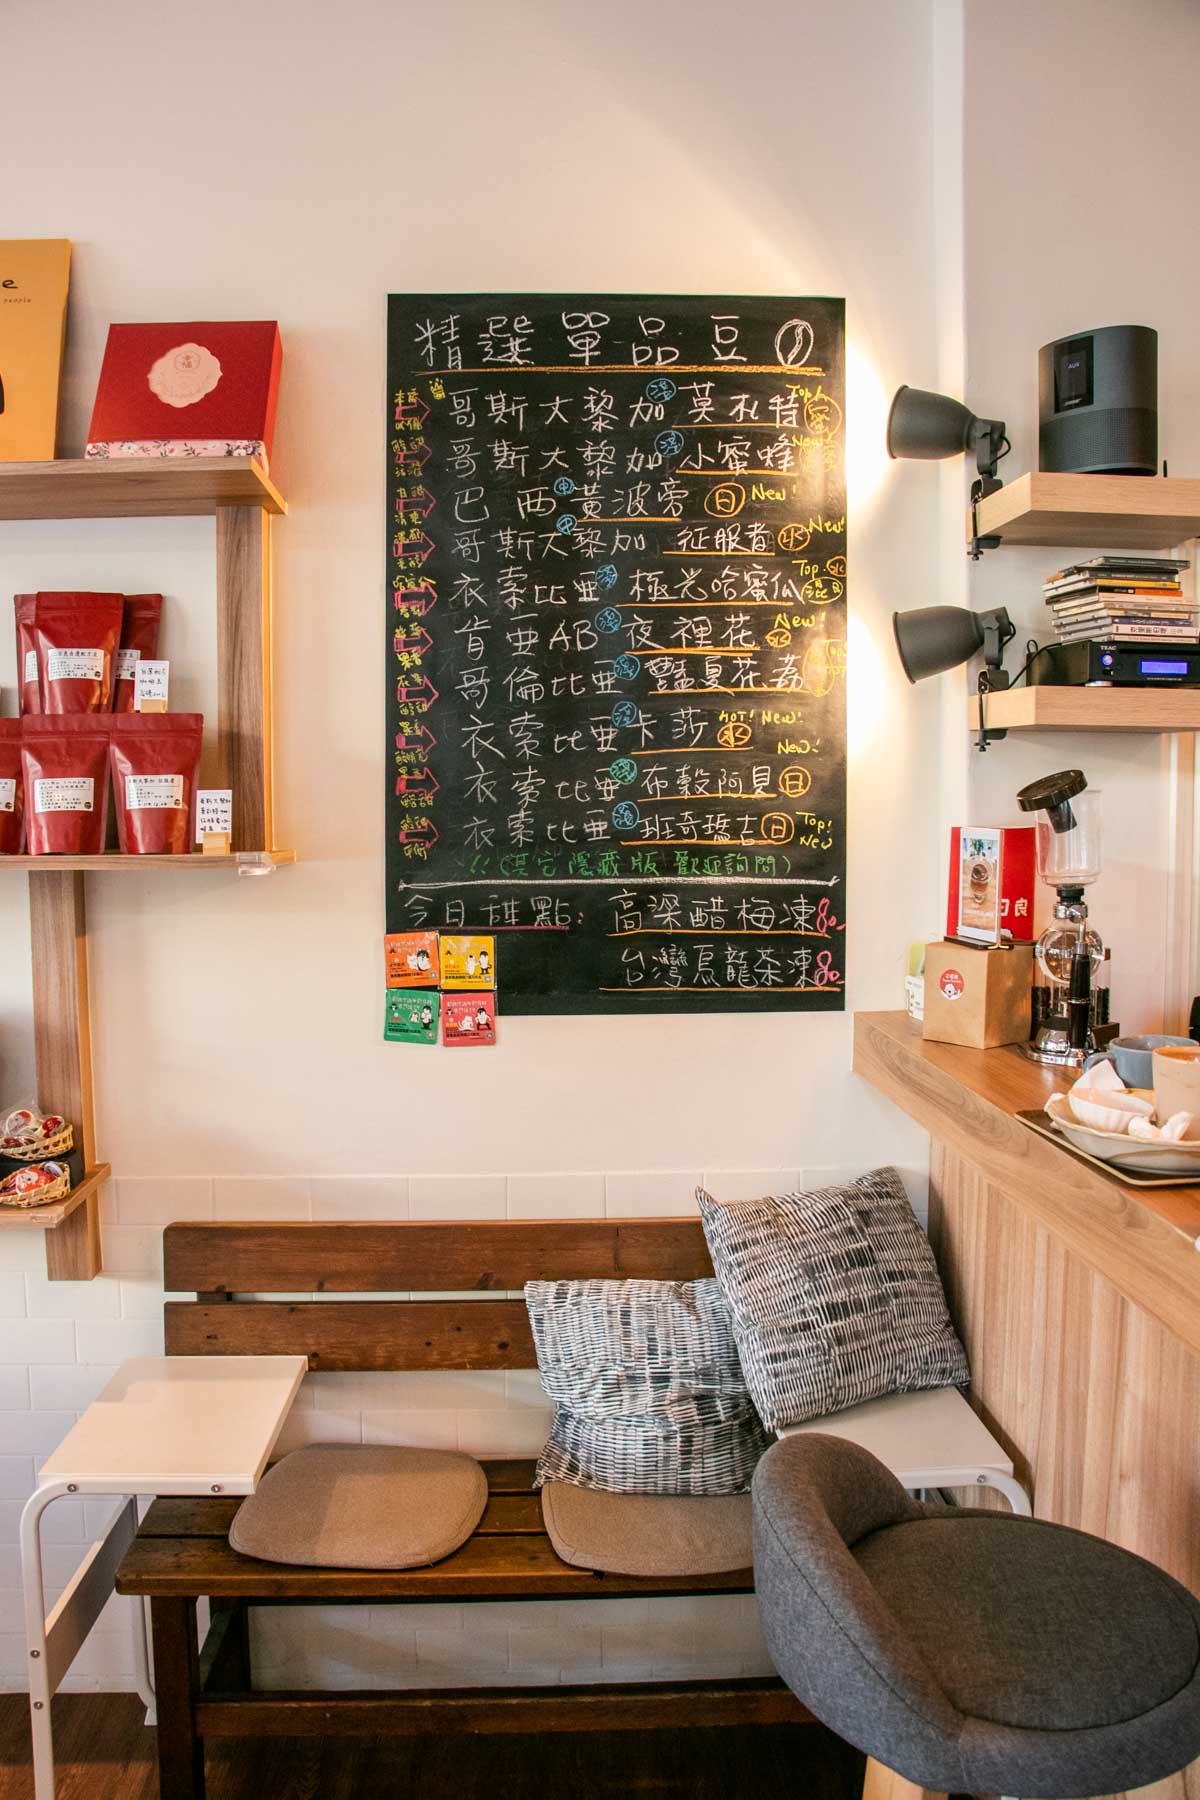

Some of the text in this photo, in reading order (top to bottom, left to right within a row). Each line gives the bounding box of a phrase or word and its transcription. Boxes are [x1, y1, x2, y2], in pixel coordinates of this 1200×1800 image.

[414, 311, 748, 370] 精選單品豆
[448, 387, 665, 433] 哥斯大黎加
[678, 381, 800, 429] 莫札特
[446, 436, 664, 478] 哥斯大黎加
[680, 433, 796, 477] 小蜜蜂
[453, 486, 557, 524] 巴西
[451, 526, 647, 563] 哥斯大黎加
[676, 521, 771, 554] 征服者
[448, 565, 601, 610] 衣索比亞
[628, 562, 806, 605] 極光哈蜜瓜
[620, 612, 756, 652] 夜裡花
[454, 659, 624, 710] 哥倫比亞
[461, 710, 620, 761] 衣索比亞
[626, 705, 709, 748] 卡莎
[463, 761, 621, 808] 衣索比亞
[463, 807, 611, 848] 衣索比亞
